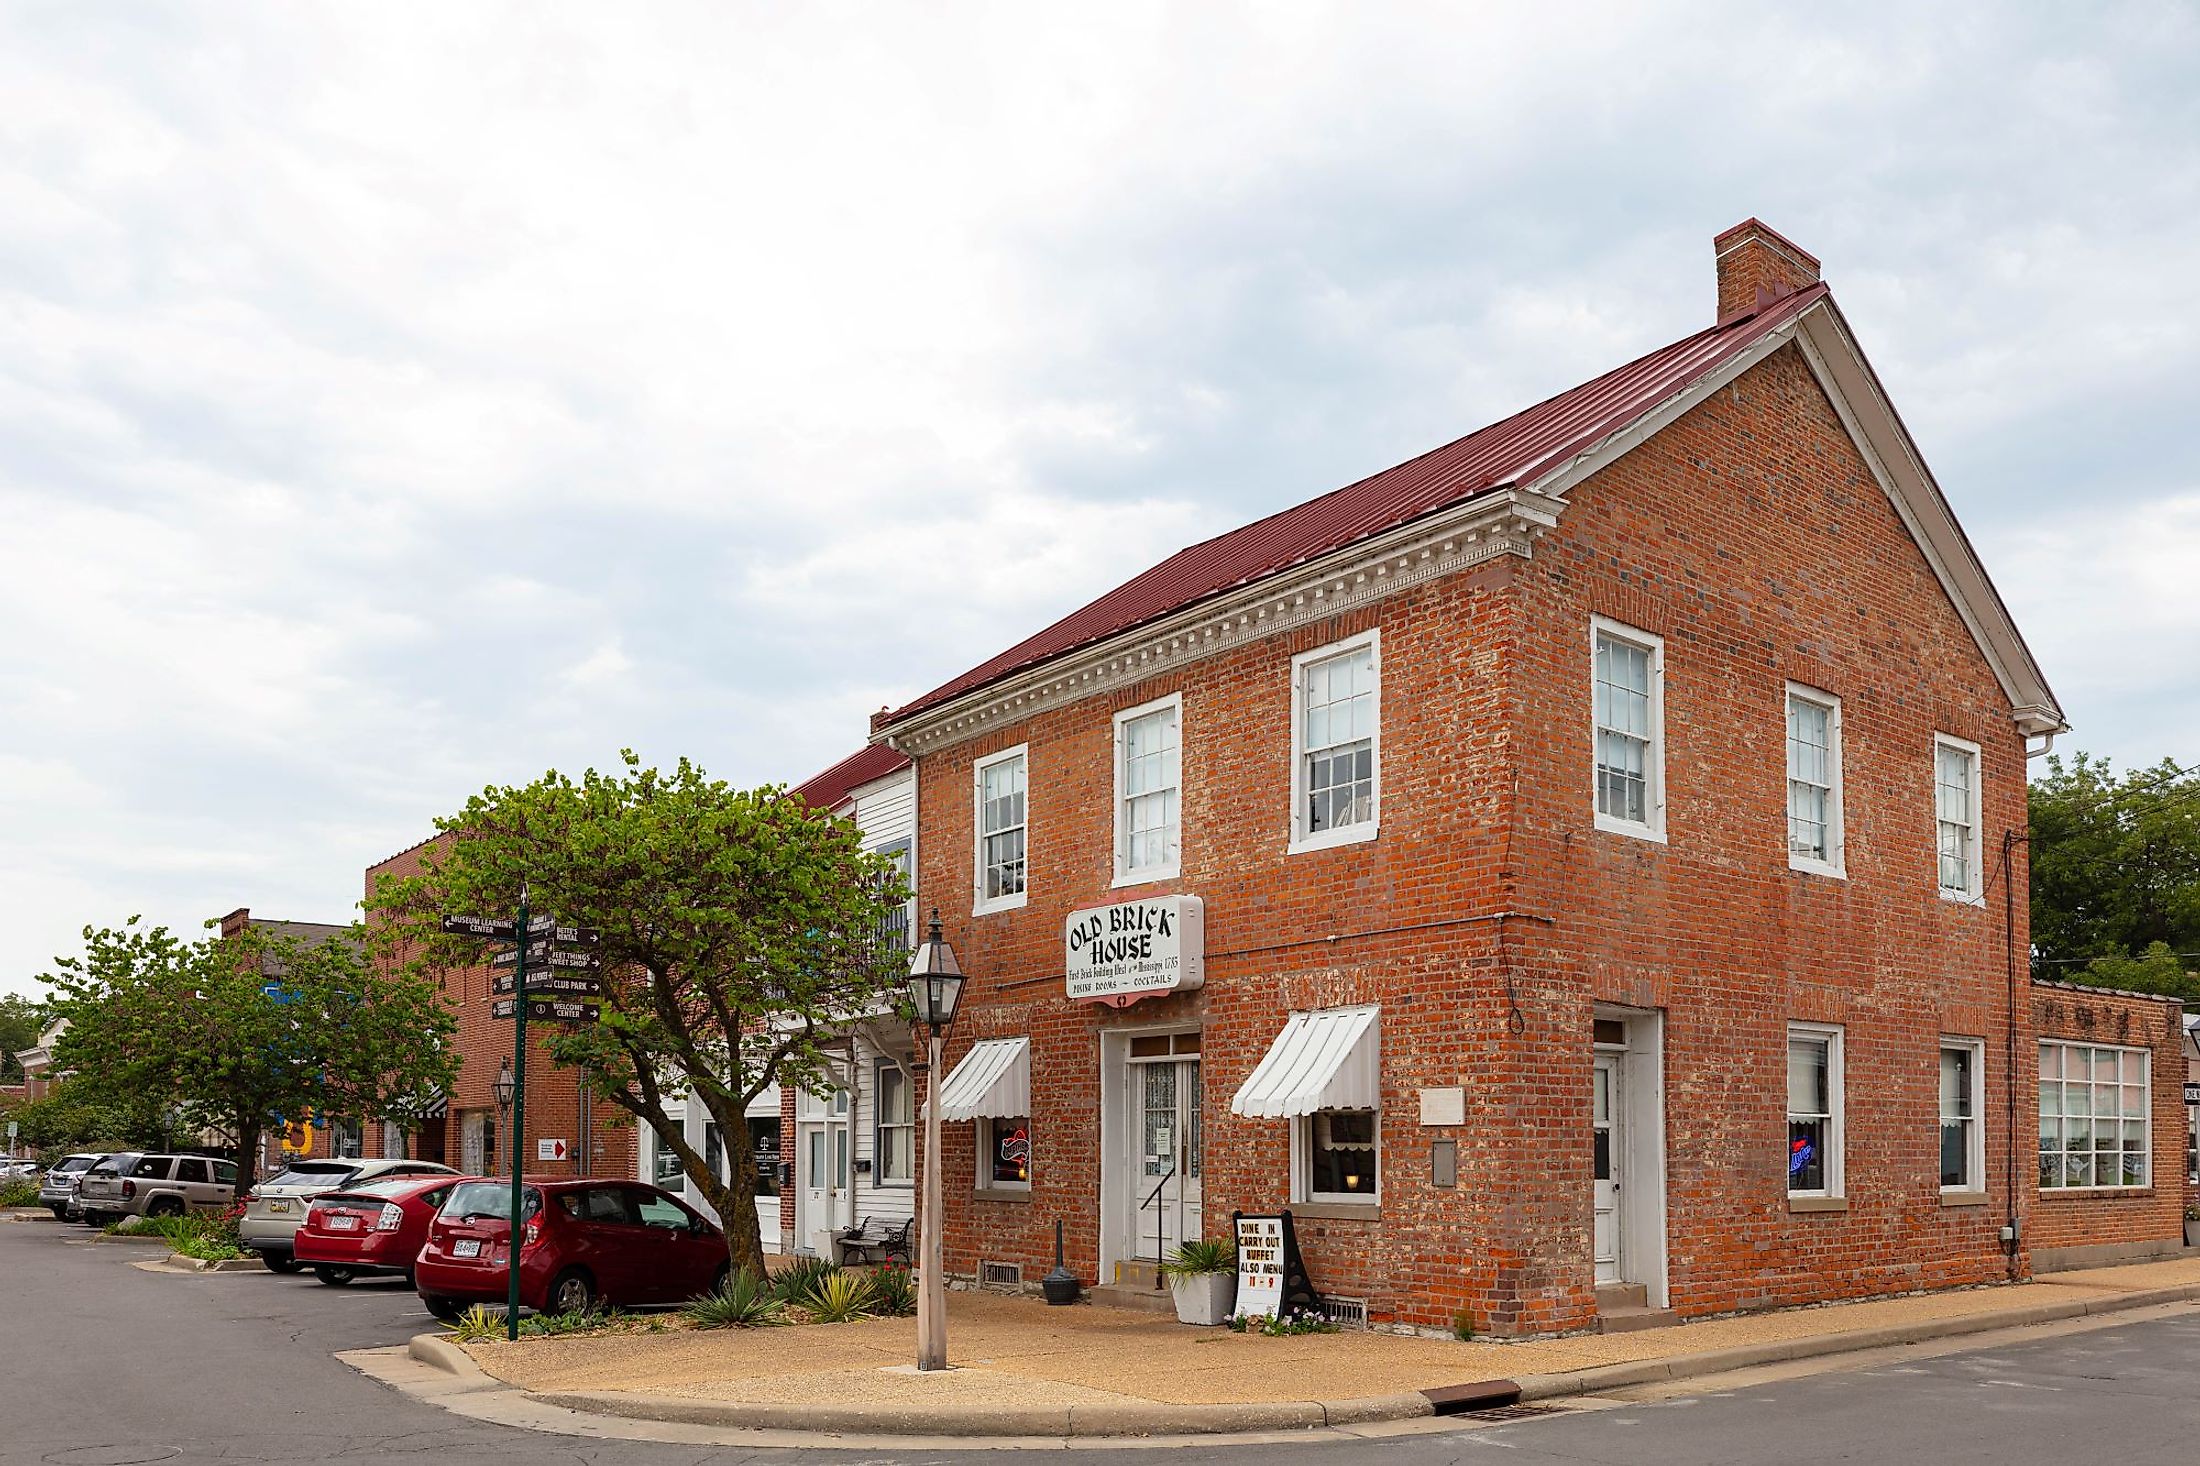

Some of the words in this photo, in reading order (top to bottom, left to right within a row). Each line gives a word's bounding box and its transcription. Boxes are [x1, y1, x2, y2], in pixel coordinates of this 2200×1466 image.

[451, 915, 480, 926] MUSEUM
[481, 918, 513, 929] LEARNING
[1070, 914, 1103, 952] OLD
[1109, 904, 1175, 938] BRICK
[470, 924, 494, 934] CENTER
[1089, 933, 1152, 966] HOUSE
[567, 952, 591, 962] THINGS
[569, 959, 588, 967] SHOP
[553, 980, 570, 990] CLUB
[570, 981, 587, 990] PARK
[1134, 974, 1172, 986] COCKTAILS
[553, 1003, 585, 1012] WELCOME
[557, 1010, 580, 1018] CENTER
[1240, 1223, 1260, 1235] DINE
[1268, 1223, 1275, 1235] IN
[1239, 1236, 1263, 1247] CARRY
[1265, 1237, 1280, 1248] OUT
[1246, 1249, 1275, 1261] BUFFET
[1240, 1262, 1260, 1274] ALSO
[1263, 1264, 1283, 1275] MENU
[1268, 1277, 1274, 1289] 9
